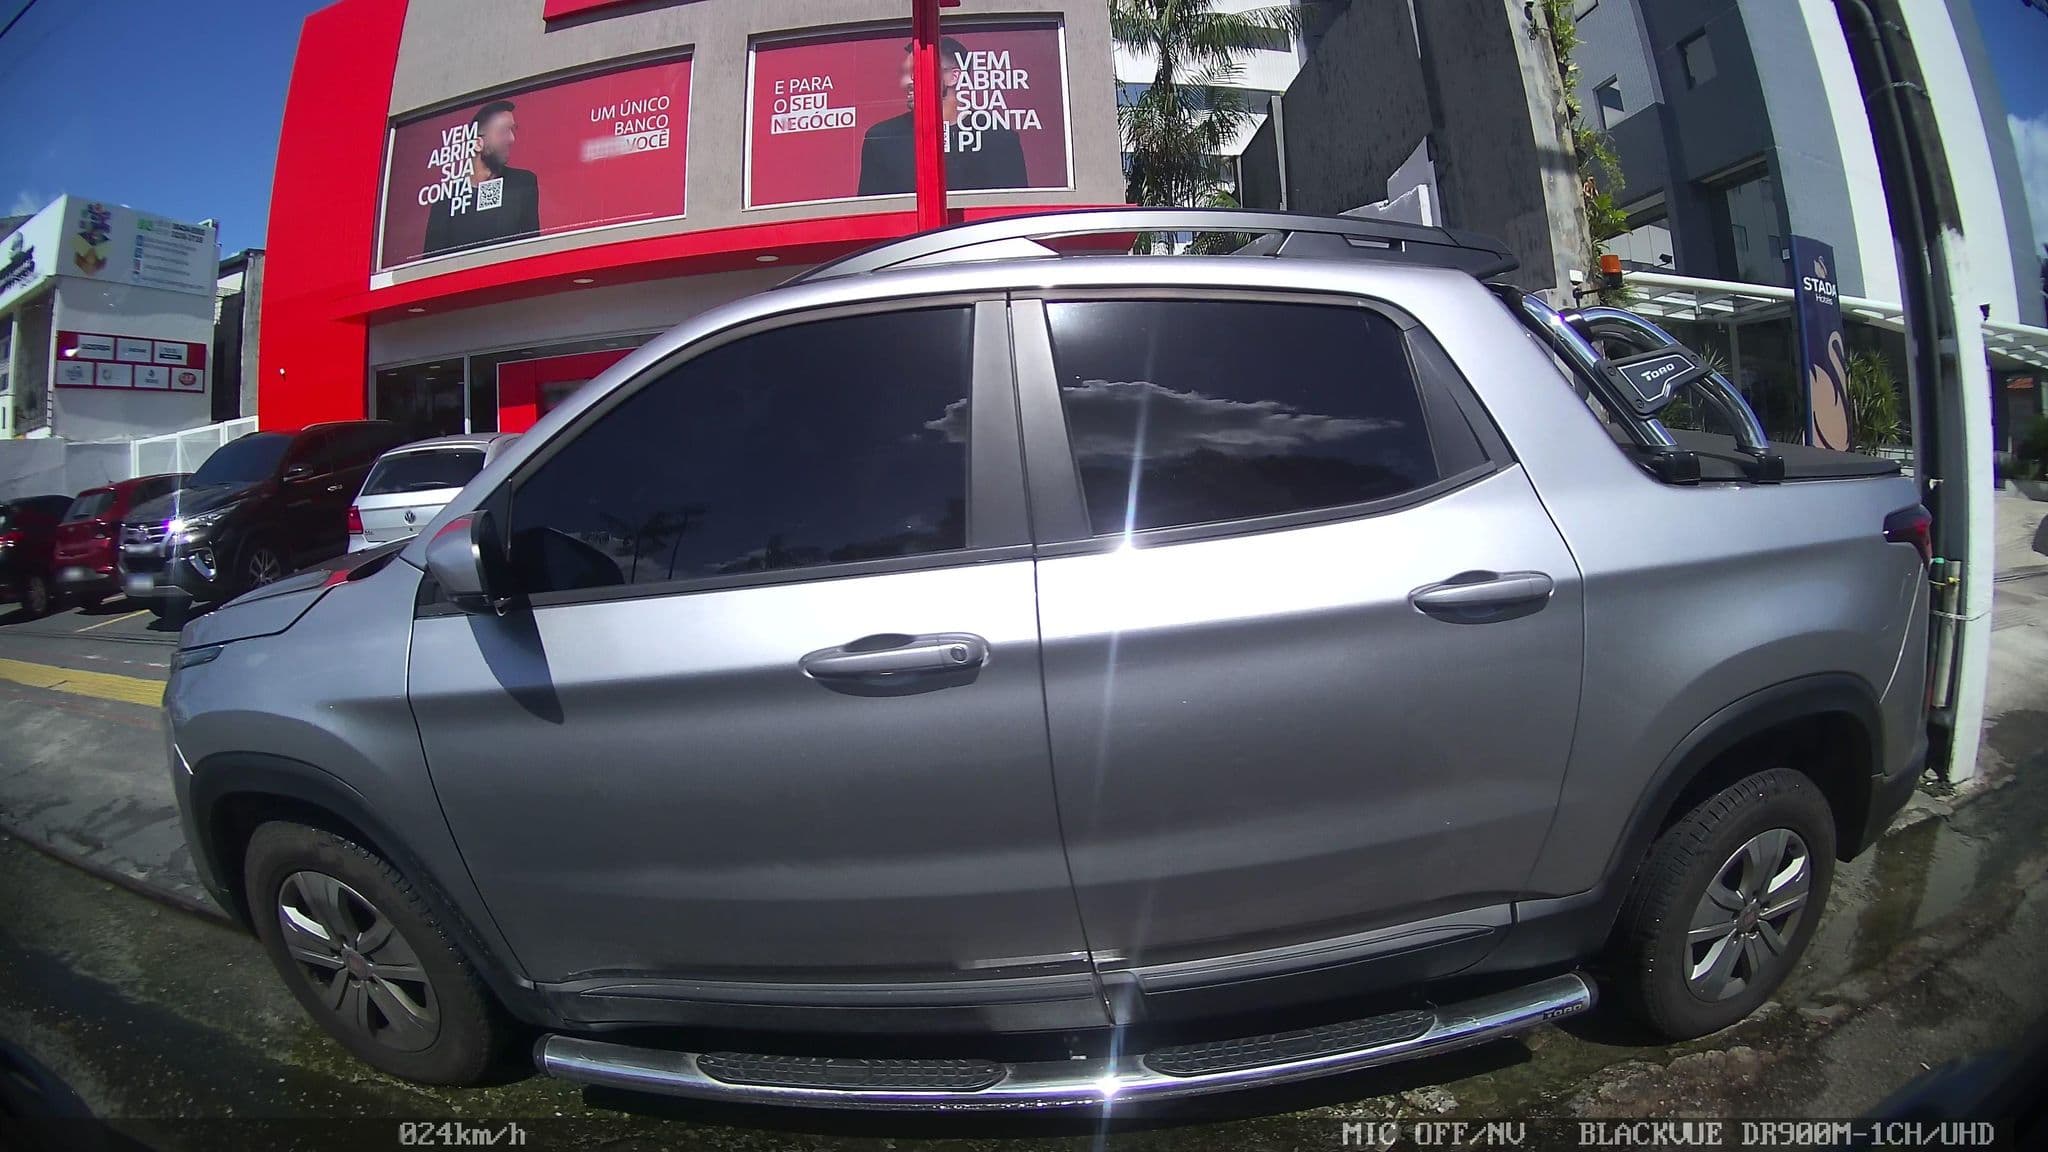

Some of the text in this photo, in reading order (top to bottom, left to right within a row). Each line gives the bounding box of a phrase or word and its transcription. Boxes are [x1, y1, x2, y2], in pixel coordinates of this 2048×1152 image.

[955, 51, 1010, 71] VEM
[775, 75, 833, 94] E PARA
[955, 70, 1029, 90] ABRIR
[591, 96, 670, 122] UM ÚNICO
[774, 95, 825, 113] O SEU
[956, 90, 1007, 110] SUA
[614, 114, 669, 136] BANCO
[773, 110, 855, 132] NEGÓCIO
[957, 109, 1042, 131] CONTA
[441, 121, 478, 146] VEM
[626, 130, 667, 151] VOCÊ
[958, 131, 982, 152] PJ
[427, 140, 477, 169] ABRIR
[440, 157, 475, 182] SUA
[418, 176, 473, 206] CONTA
[450, 194, 473, 217] PF
